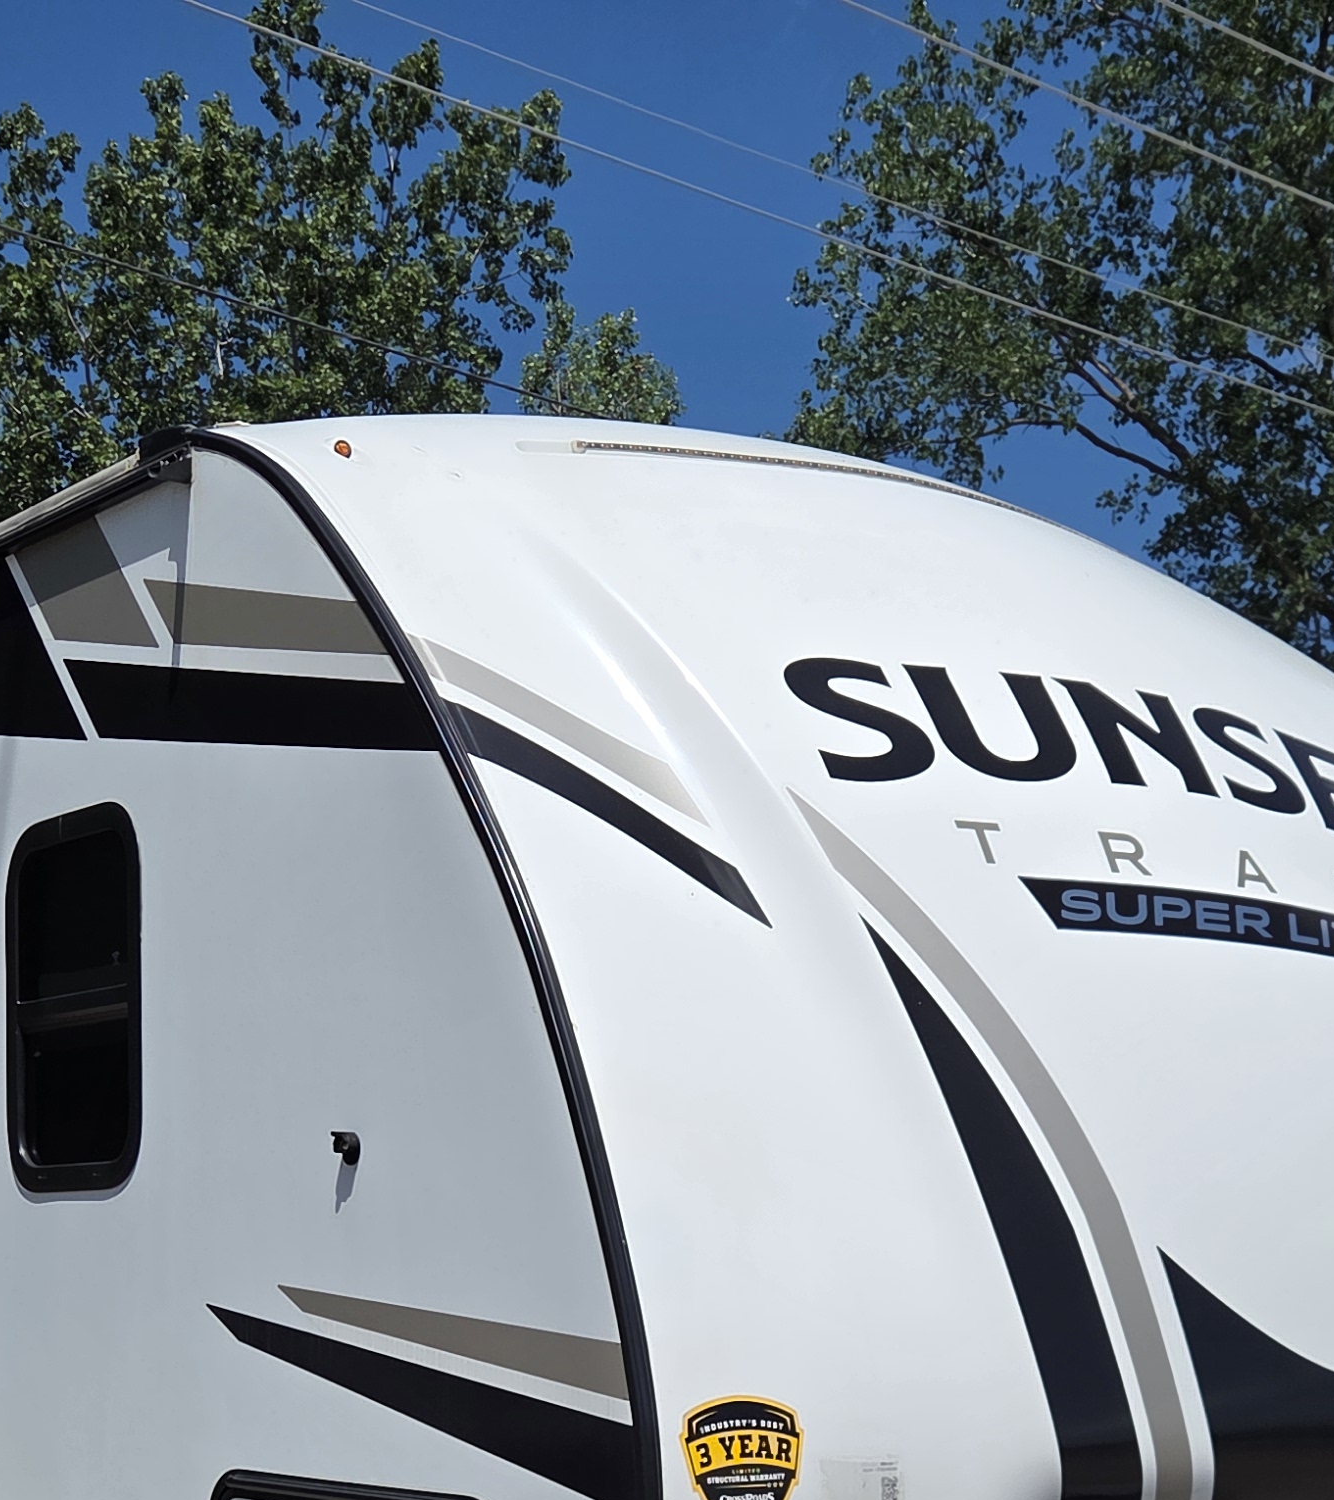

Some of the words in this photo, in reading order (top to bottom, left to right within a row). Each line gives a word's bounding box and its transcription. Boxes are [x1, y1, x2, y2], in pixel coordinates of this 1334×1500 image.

[1059, 888, 1272, 940] SUPER
[699, 1418, 757, 1434] INDUSTRY'S
[760, 1419, 784, 1430] BEST
[695, 1442, 713, 1468] 3
[718, 1433, 792, 1463] YEAR
[706, 1474, 749, 1484] STRUCTURAL
[749, 1472, 786, 1482] WARRANTY
